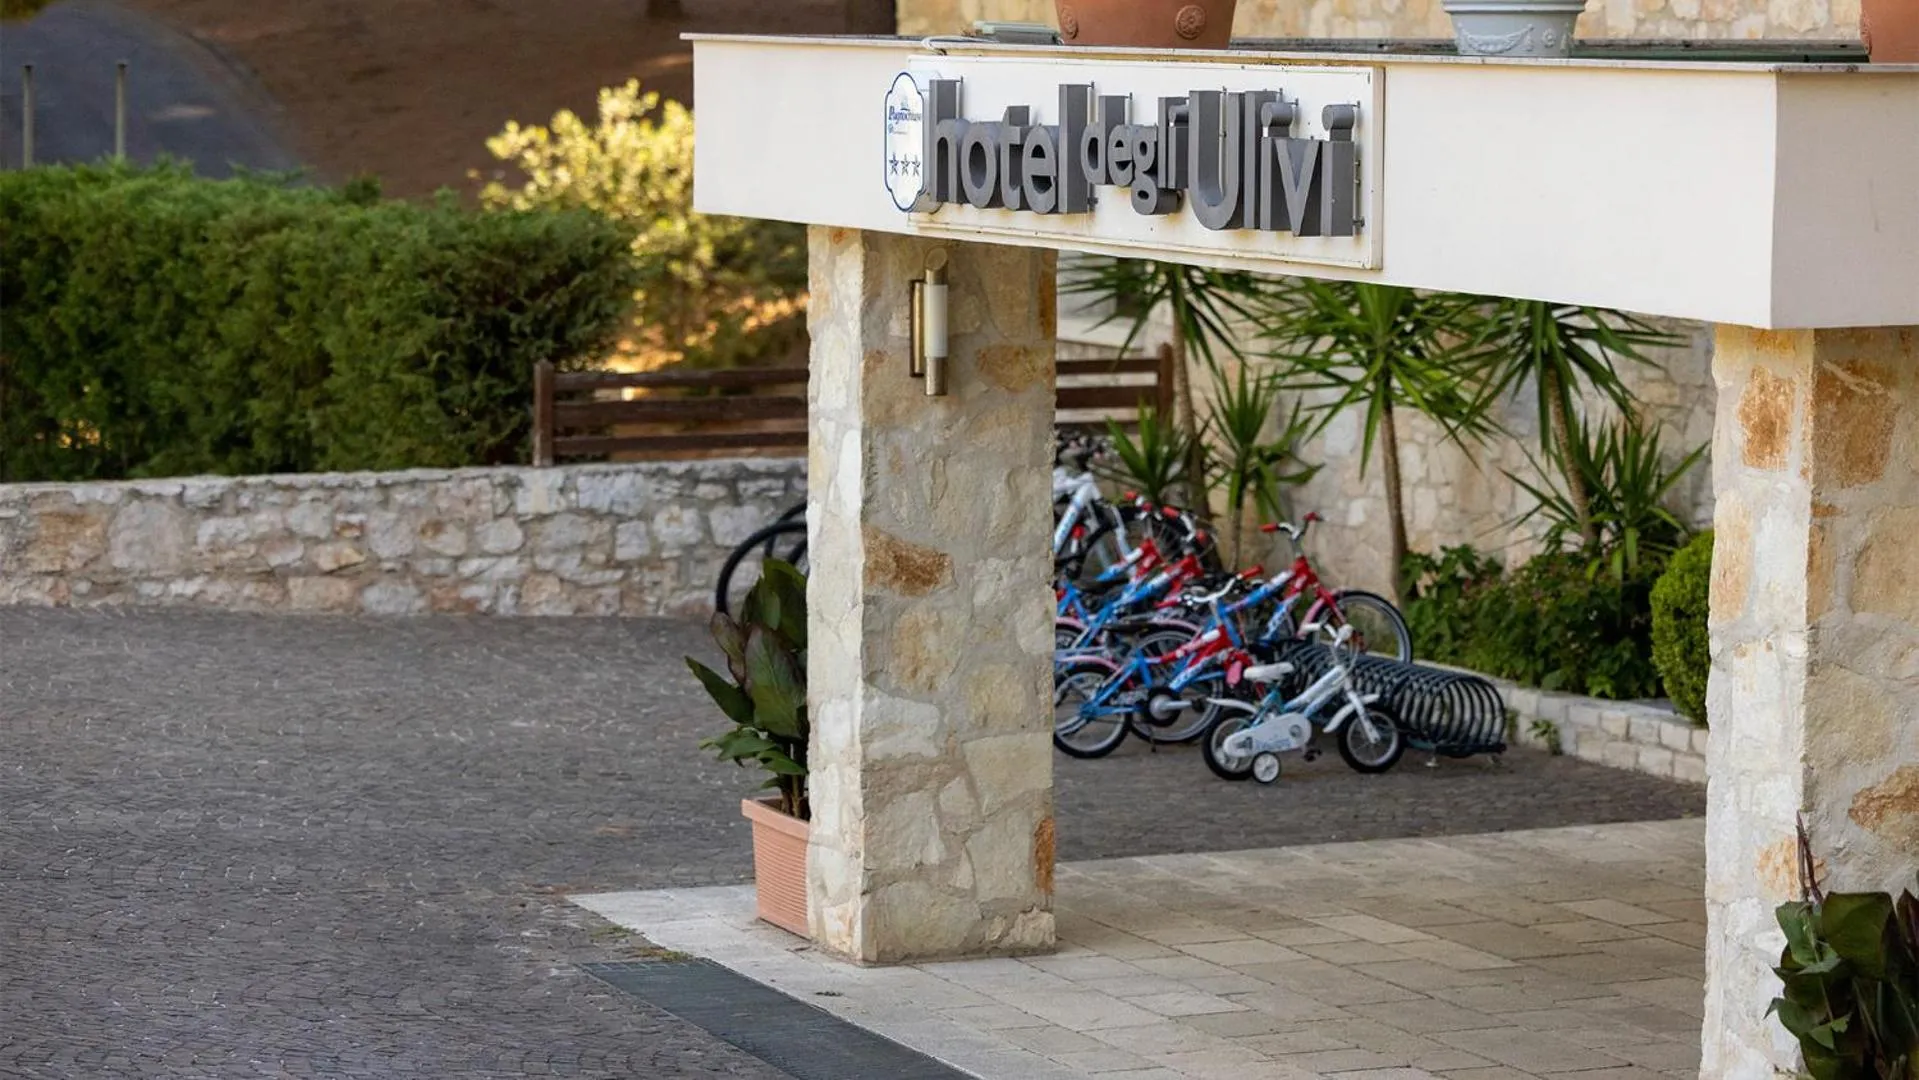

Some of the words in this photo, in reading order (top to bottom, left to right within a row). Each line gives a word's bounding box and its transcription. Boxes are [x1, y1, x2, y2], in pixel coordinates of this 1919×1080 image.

[929, 79, 1090, 214] hotel
[1081, 95, 1188, 215] degli
[1188, 90, 1356, 236] Ulivi
